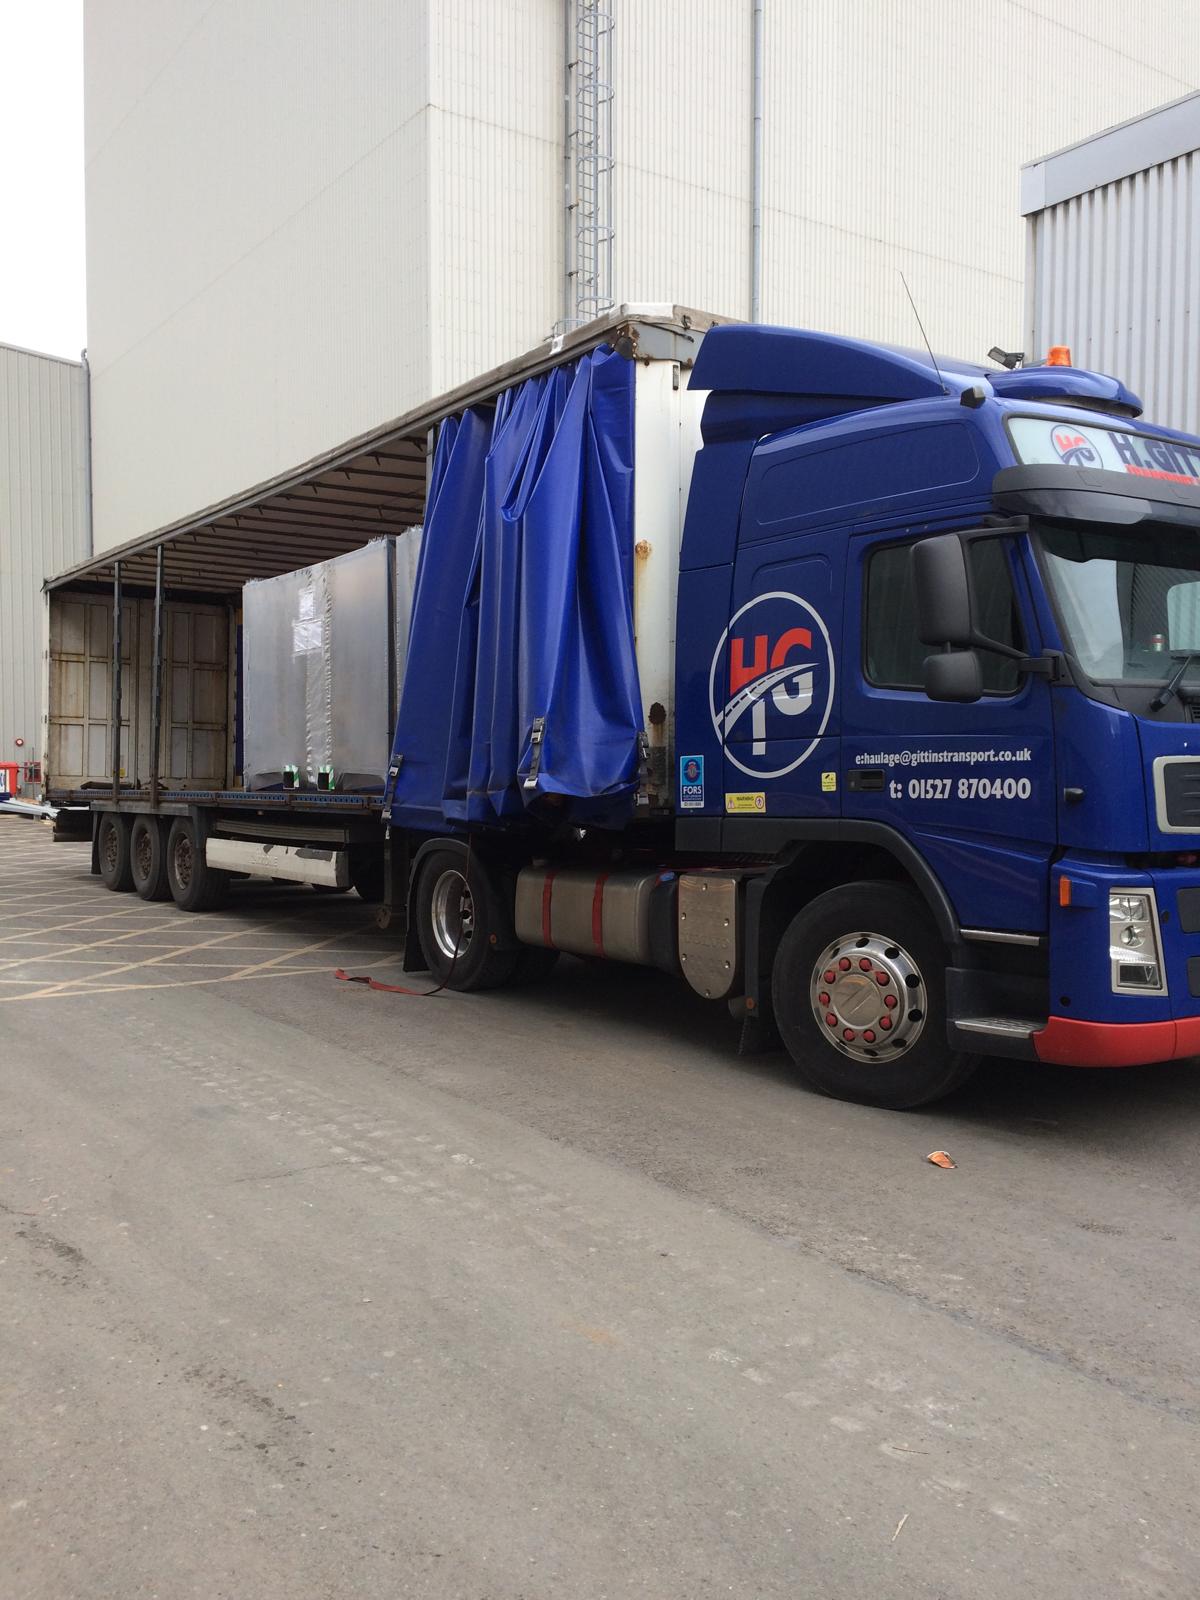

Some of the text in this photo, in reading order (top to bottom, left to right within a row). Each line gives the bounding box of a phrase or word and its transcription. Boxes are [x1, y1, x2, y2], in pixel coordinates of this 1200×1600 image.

[855, 748, 1032, 767] e:haulage@gittinstransport.co.uk
[682, 786, 702, 794] FORS
[889, 777, 1032, 799] t: 01527 870400
